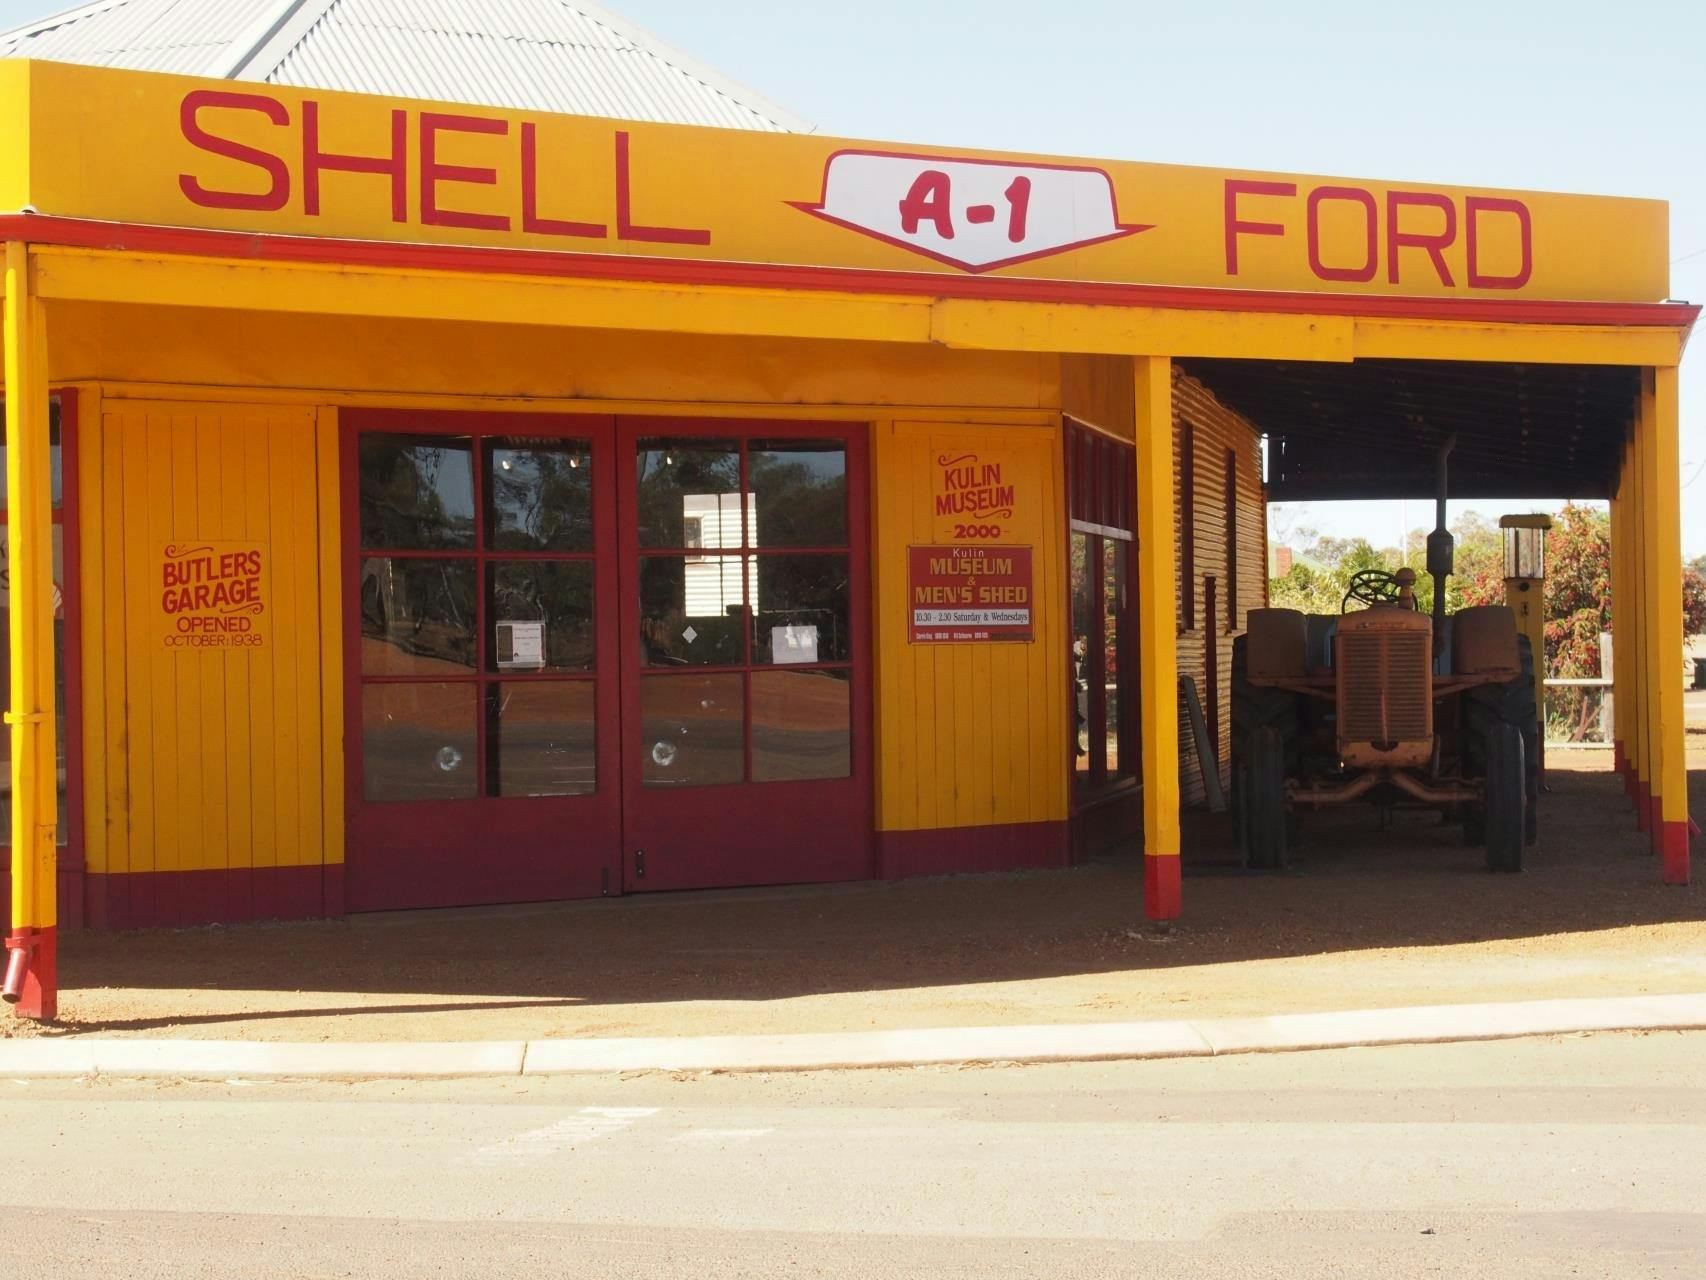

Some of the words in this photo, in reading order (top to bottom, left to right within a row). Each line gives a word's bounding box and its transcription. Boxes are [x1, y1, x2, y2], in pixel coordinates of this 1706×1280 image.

[179, 90, 711, 246] SHELL
[899, 170, 1031, 243] A-1
[1225, 179, 1532, 289] FORD
[944, 464, 1000, 491] KULIN
[936, 486, 1014, 516] MUSEUM
[954, 525, 1000, 539] 2000
[953, 547, 984, 558] Kulin
[163, 550, 261, 588] BUTLERS
[930, 559, 1012, 575] MUSEUM
[967, 576, 976, 585] &
[162, 577, 260, 614] GARAGE
[915, 587, 972, 604] MEN'S
[979, 587, 1027, 604] SHED
[177, 616, 251, 633] OPENED
[953, 612, 981, 623] Saturday
